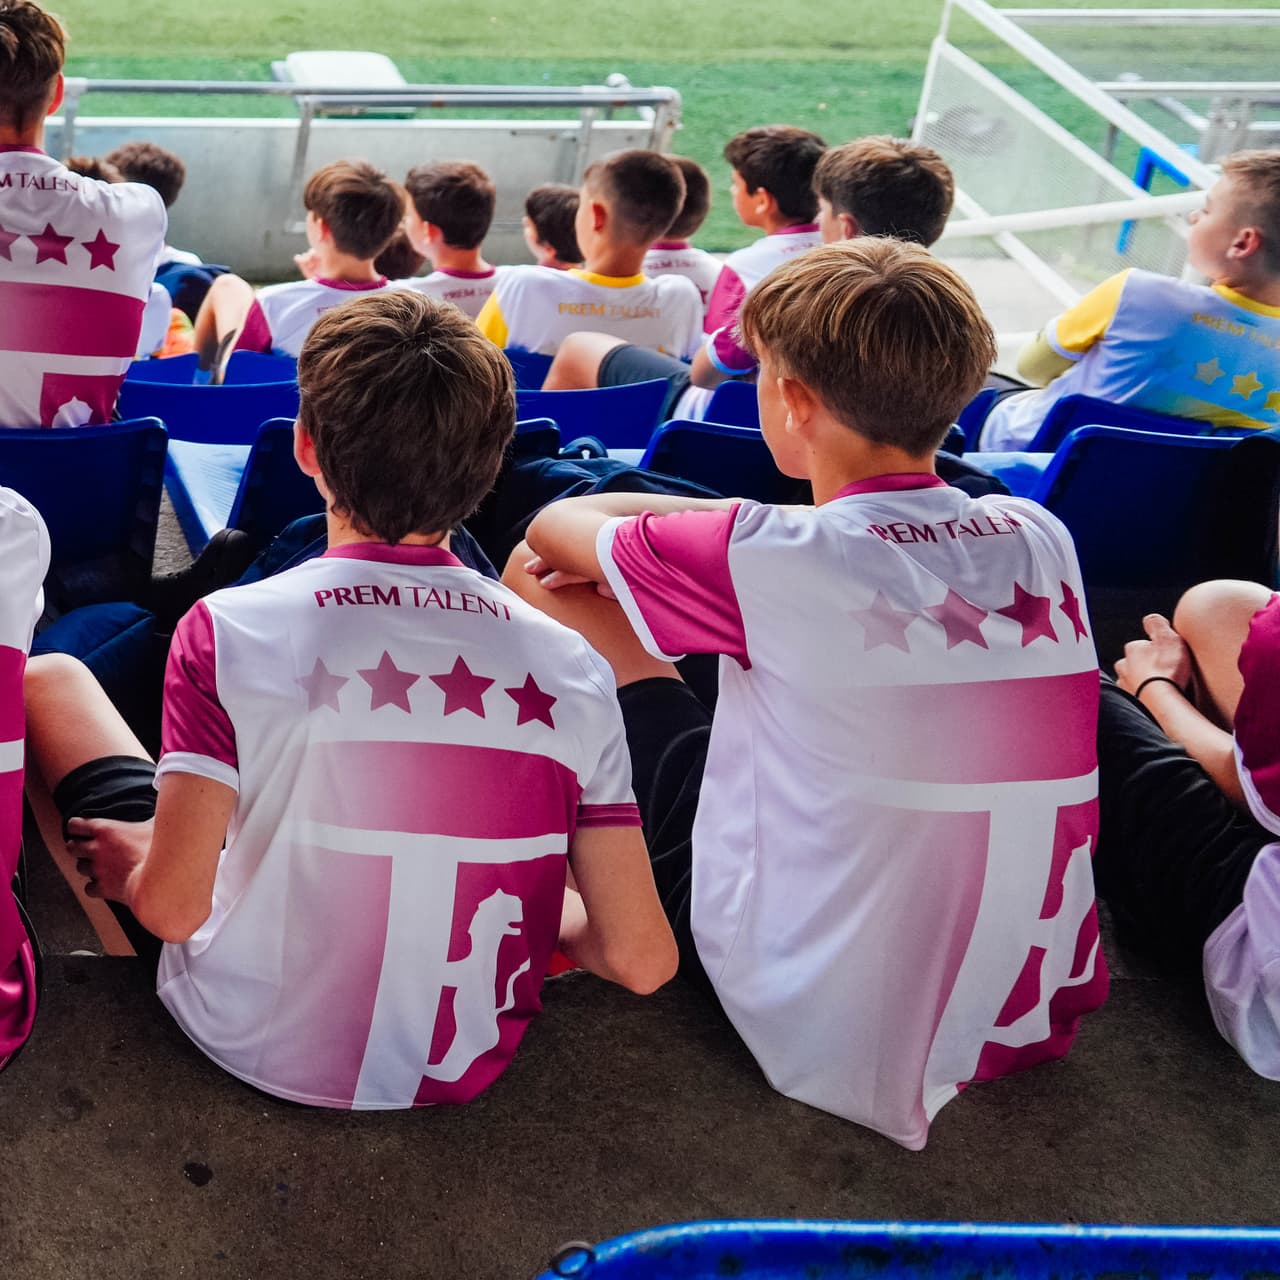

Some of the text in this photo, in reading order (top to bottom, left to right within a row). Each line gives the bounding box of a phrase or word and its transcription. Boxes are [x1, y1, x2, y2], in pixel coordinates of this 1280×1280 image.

[16, 171, 80, 192] TALEN
[558, 302, 606, 317] PREM
[936, 512, 1022, 540] TALEN
[314, 585, 512, 621] PREM TALENT
